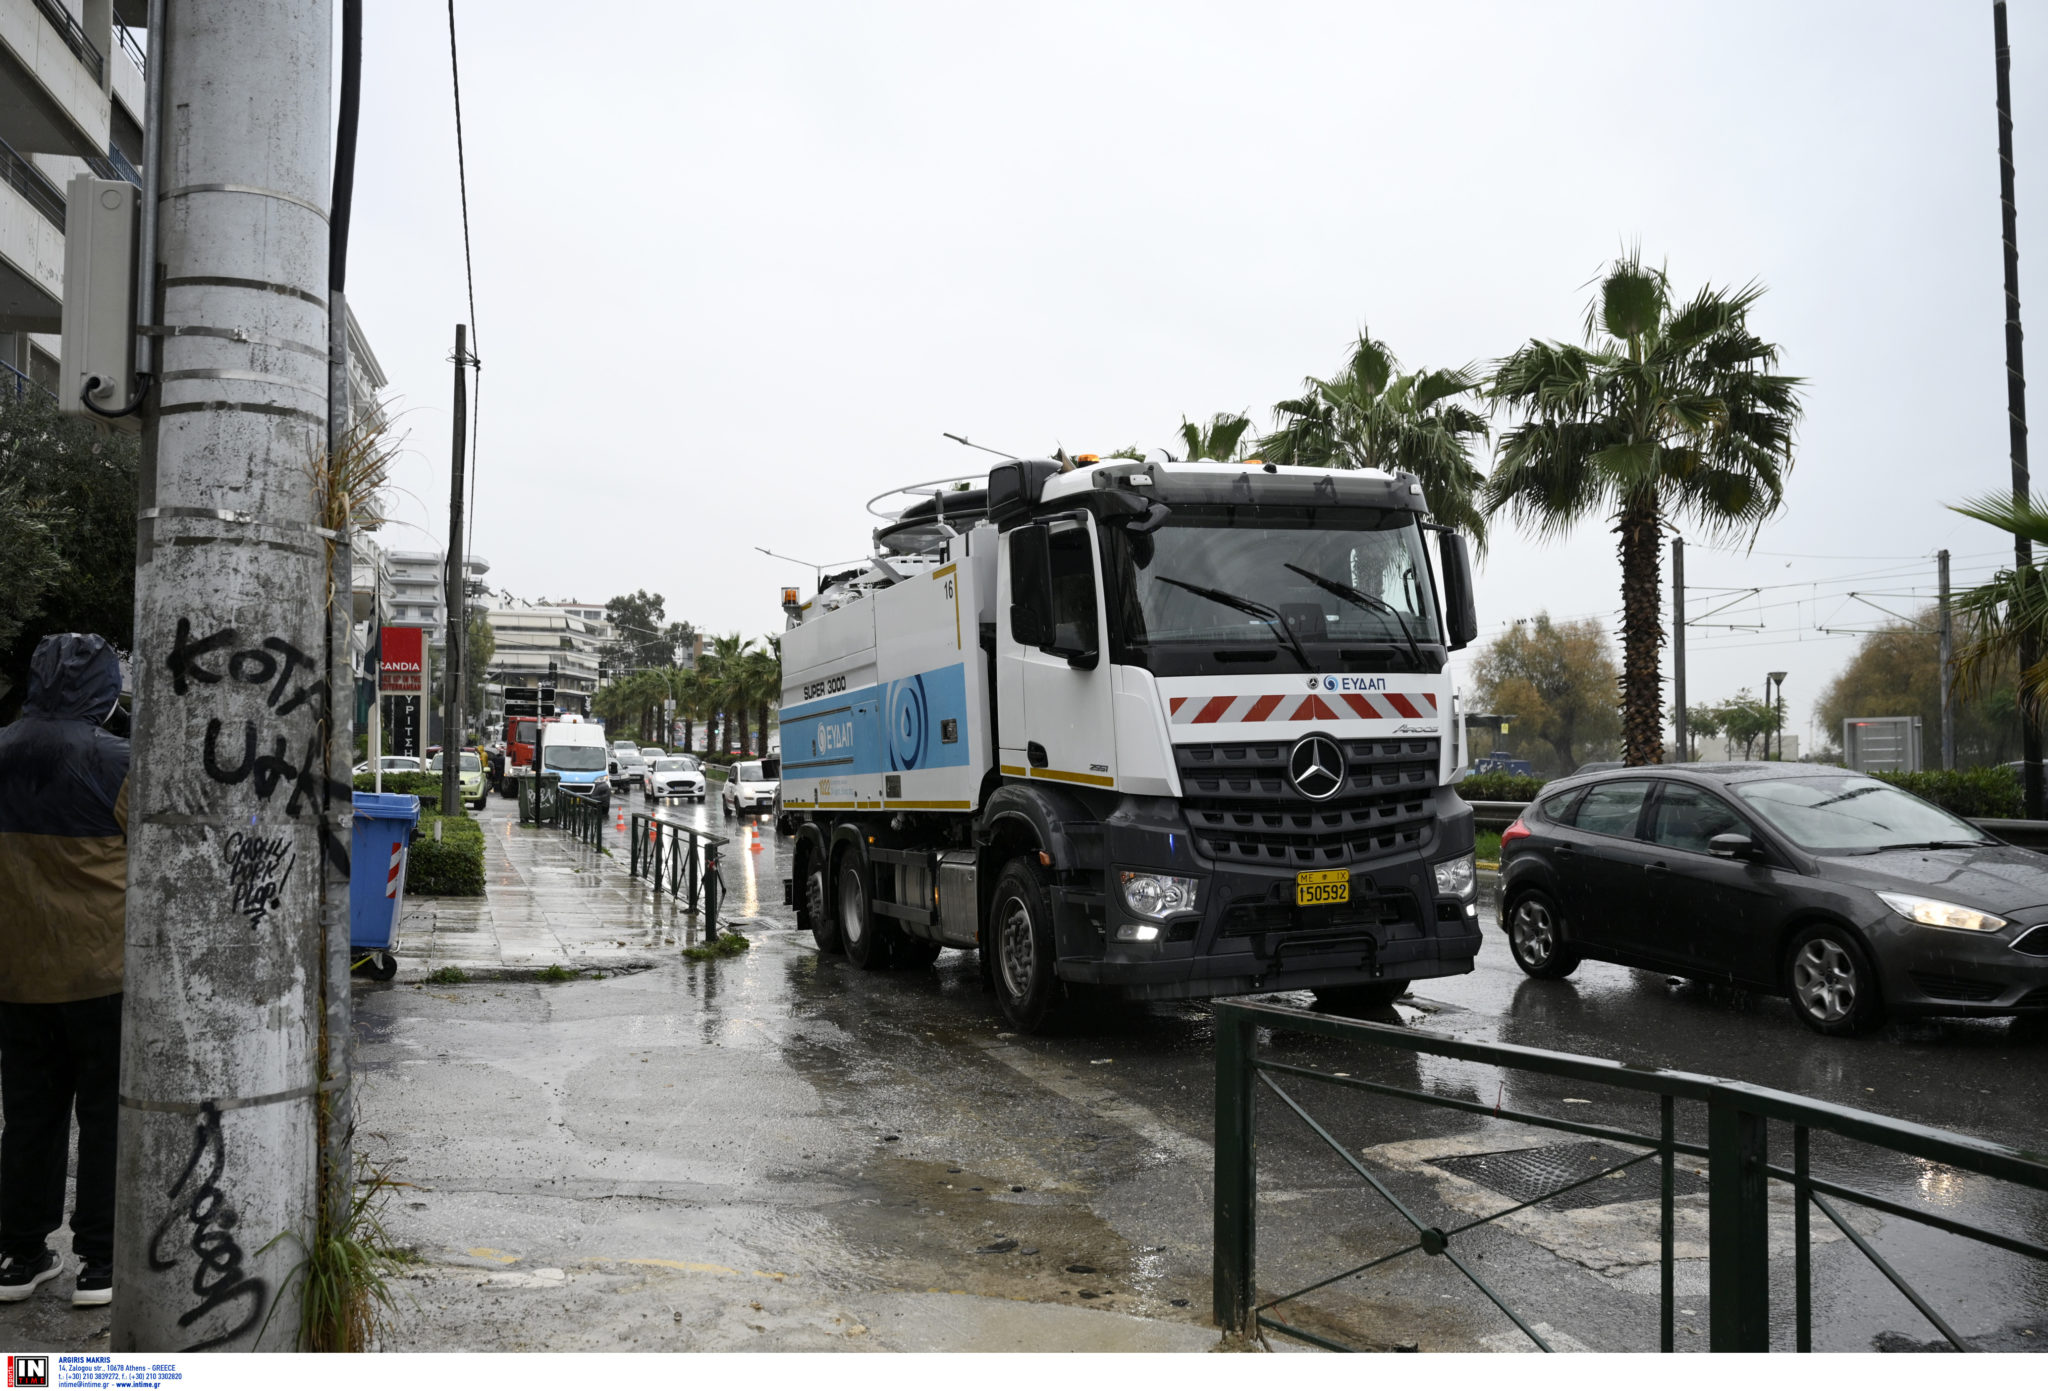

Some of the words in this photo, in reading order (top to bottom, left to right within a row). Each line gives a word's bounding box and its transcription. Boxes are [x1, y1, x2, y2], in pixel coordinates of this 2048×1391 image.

[944, 579, 954, 600] 16
[804, 681, 825, 700] SUPER
[827, 676, 846, 694] 3000
[1342, 678, 1386, 690] ΕΥΔΑΠ
[827, 722, 853, 749] ΕΥΔΑΠ
[1300, 884, 1346, 902] 150592
